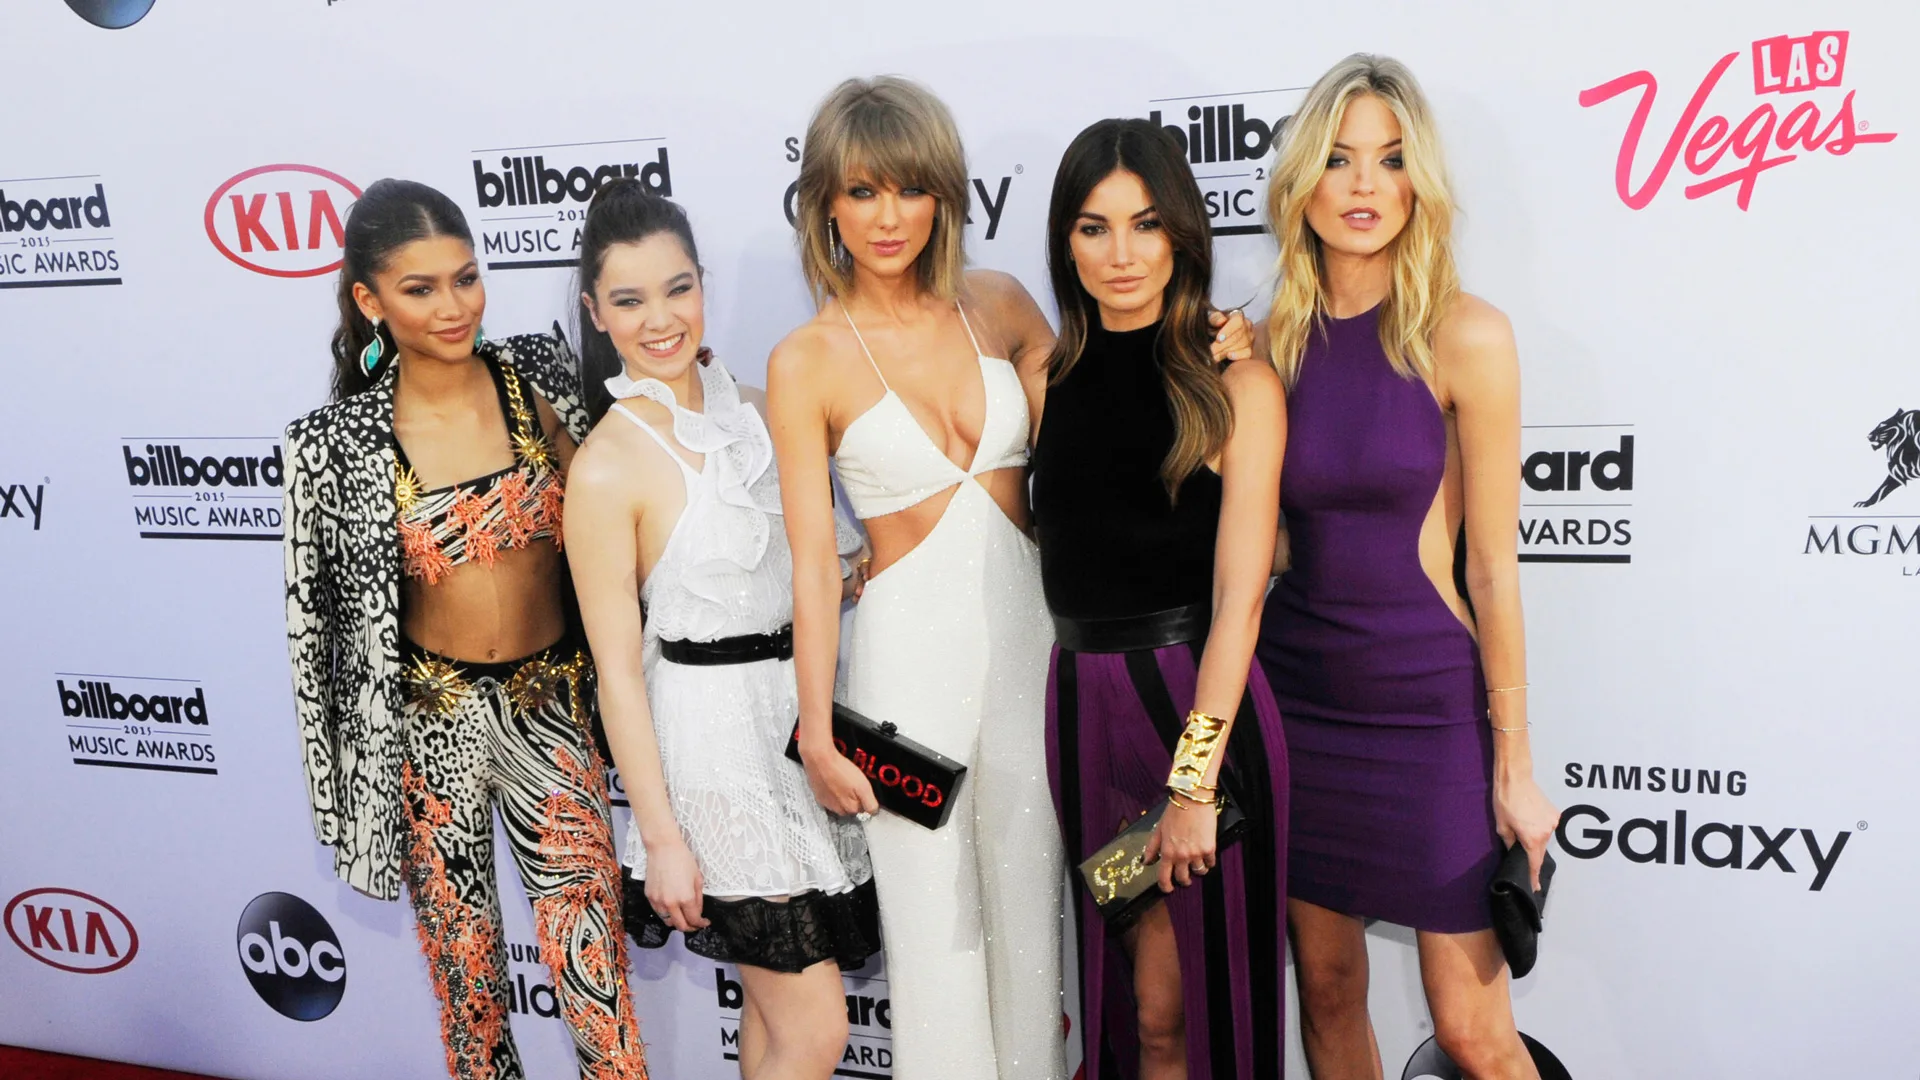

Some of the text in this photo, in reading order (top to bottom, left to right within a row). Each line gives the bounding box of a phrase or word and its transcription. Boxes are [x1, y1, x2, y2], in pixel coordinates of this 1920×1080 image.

[1760, 35, 1841, 89] LAS
[1578, 51, 1898, 212] Vegas
[0, 183, 111, 232] board
[229, 189, 346, 253] KIA
[20, 236, 50, 248] 2015
[34, 249, 120, 274] AWARDS
[483, 228, 561, 254] MUSIC
[122, 443, 285, 488] billboard
[134, 505, 200, 527] MUSIC
[195, 491, 226, 503] 2015
[1802, 523, 1920, 555] MGM
[56, 679, 209, 726] billboard
[68, 734, 216, 763] MUSIC AWARDS
[123, 725, 152, 736] 2015
[852, 747, 944, 808] BLOOD
[1564, 762, 1747, 796] SAMSUNG
[1555, 804, 1853, 892] Galaxy
[22, 903, 120, 958] KIA
[239, 920, 345, 982] abc
